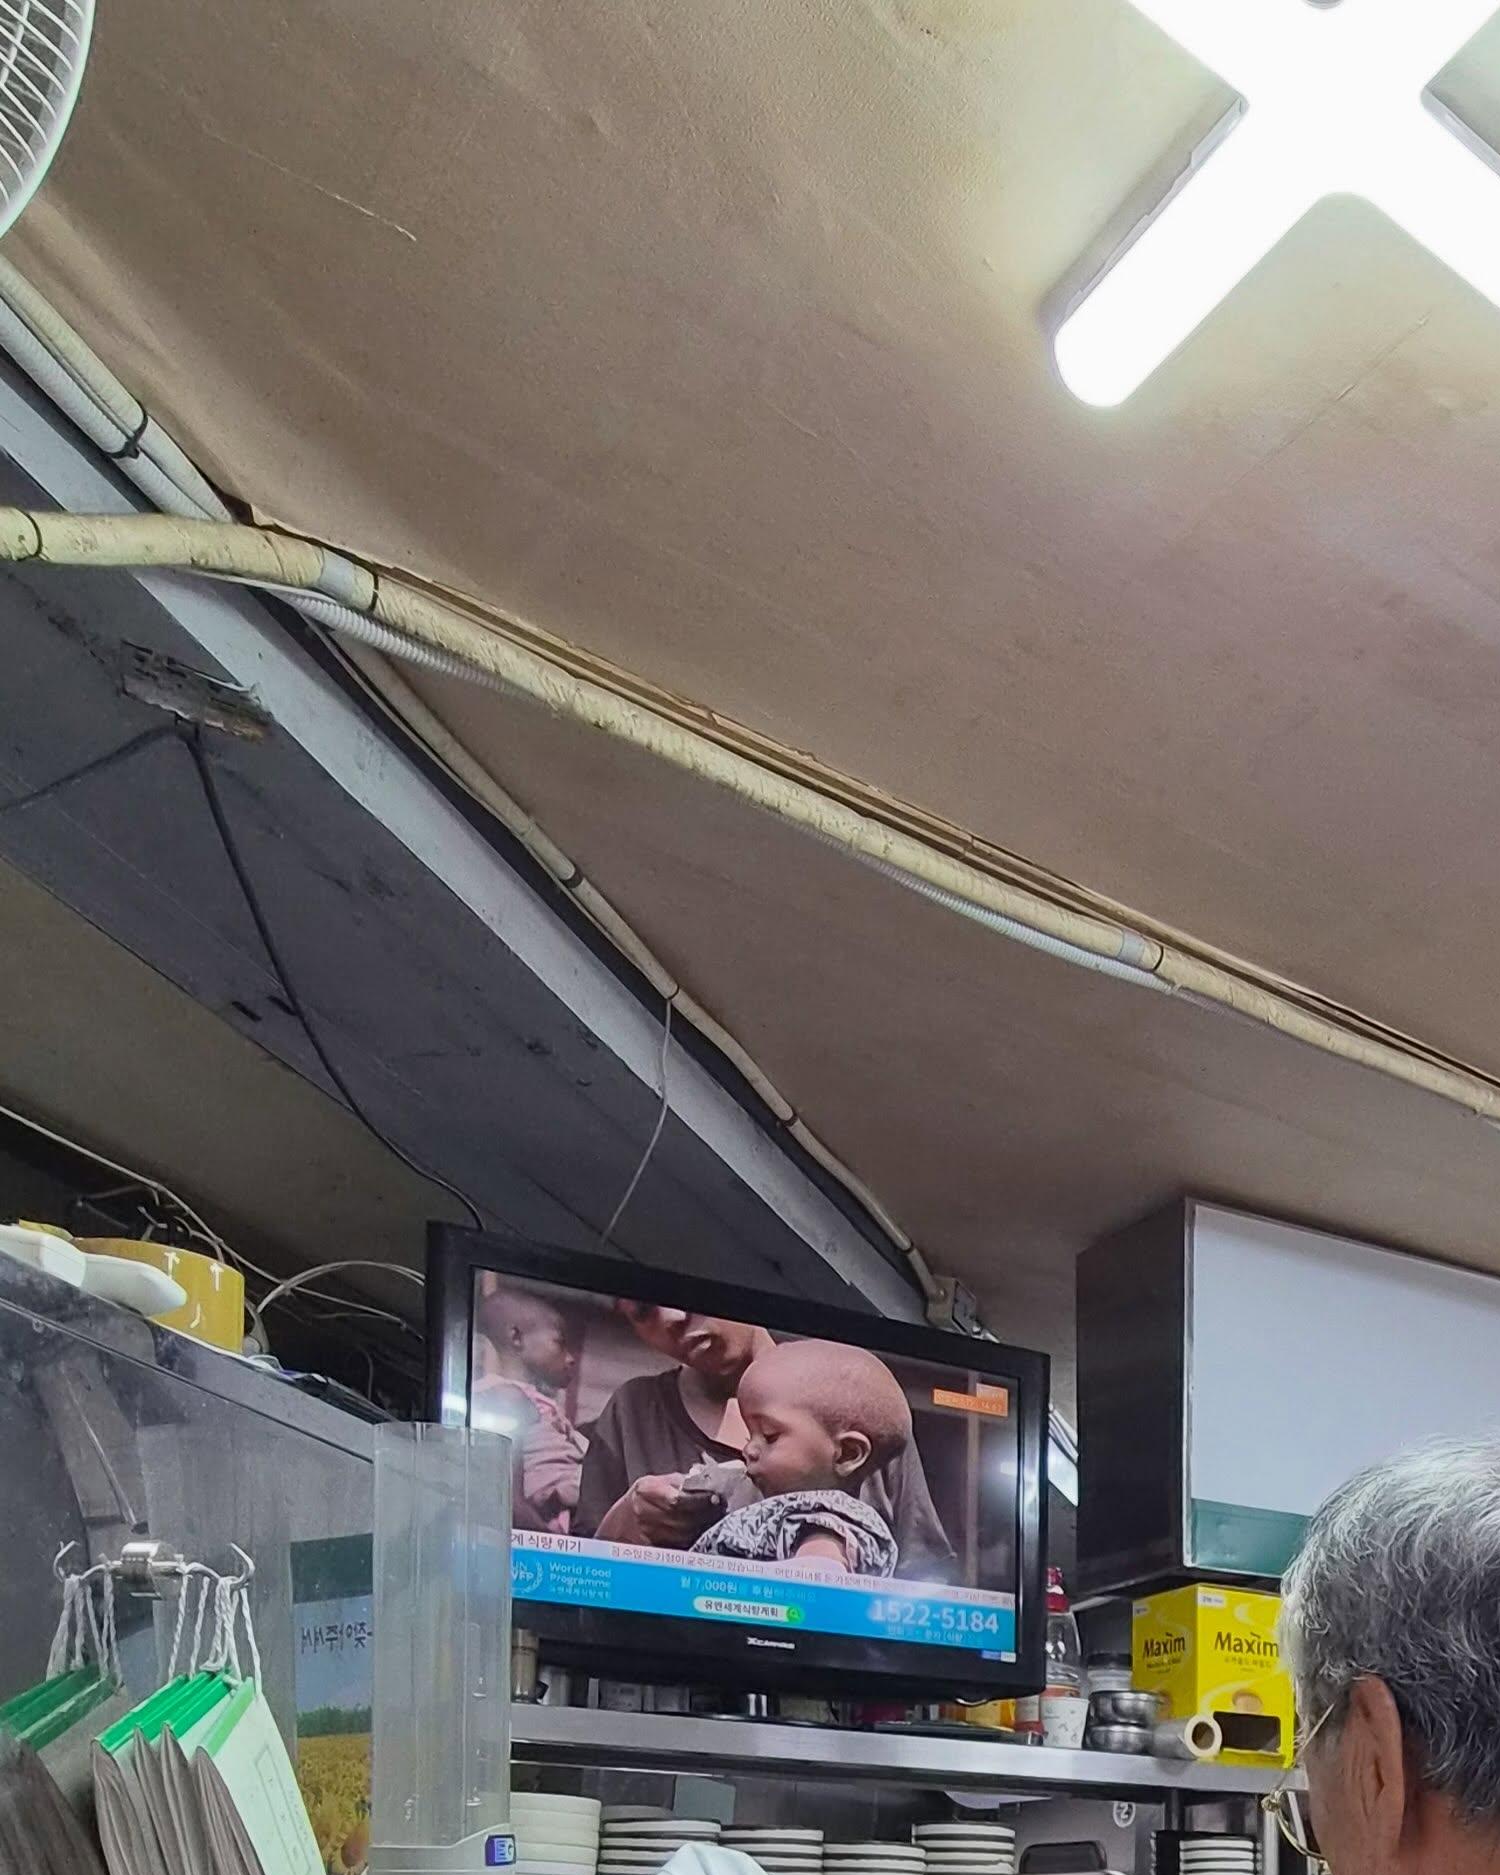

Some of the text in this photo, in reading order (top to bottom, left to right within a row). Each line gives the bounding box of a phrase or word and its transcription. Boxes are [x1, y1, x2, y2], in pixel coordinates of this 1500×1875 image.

[528, 1535, 553, 1550] 식량
[557, 1538, 581, 1553] 위기
[548, 1561, 612, 1579] World Food
[549, 1572, 611, 1589] Programme
[869, 1599, 1000, 1634] 1522-5184
[1142, 1632, 1186, 1660] Maxim
[1214, 1631, 1280, 1658] Maxim
